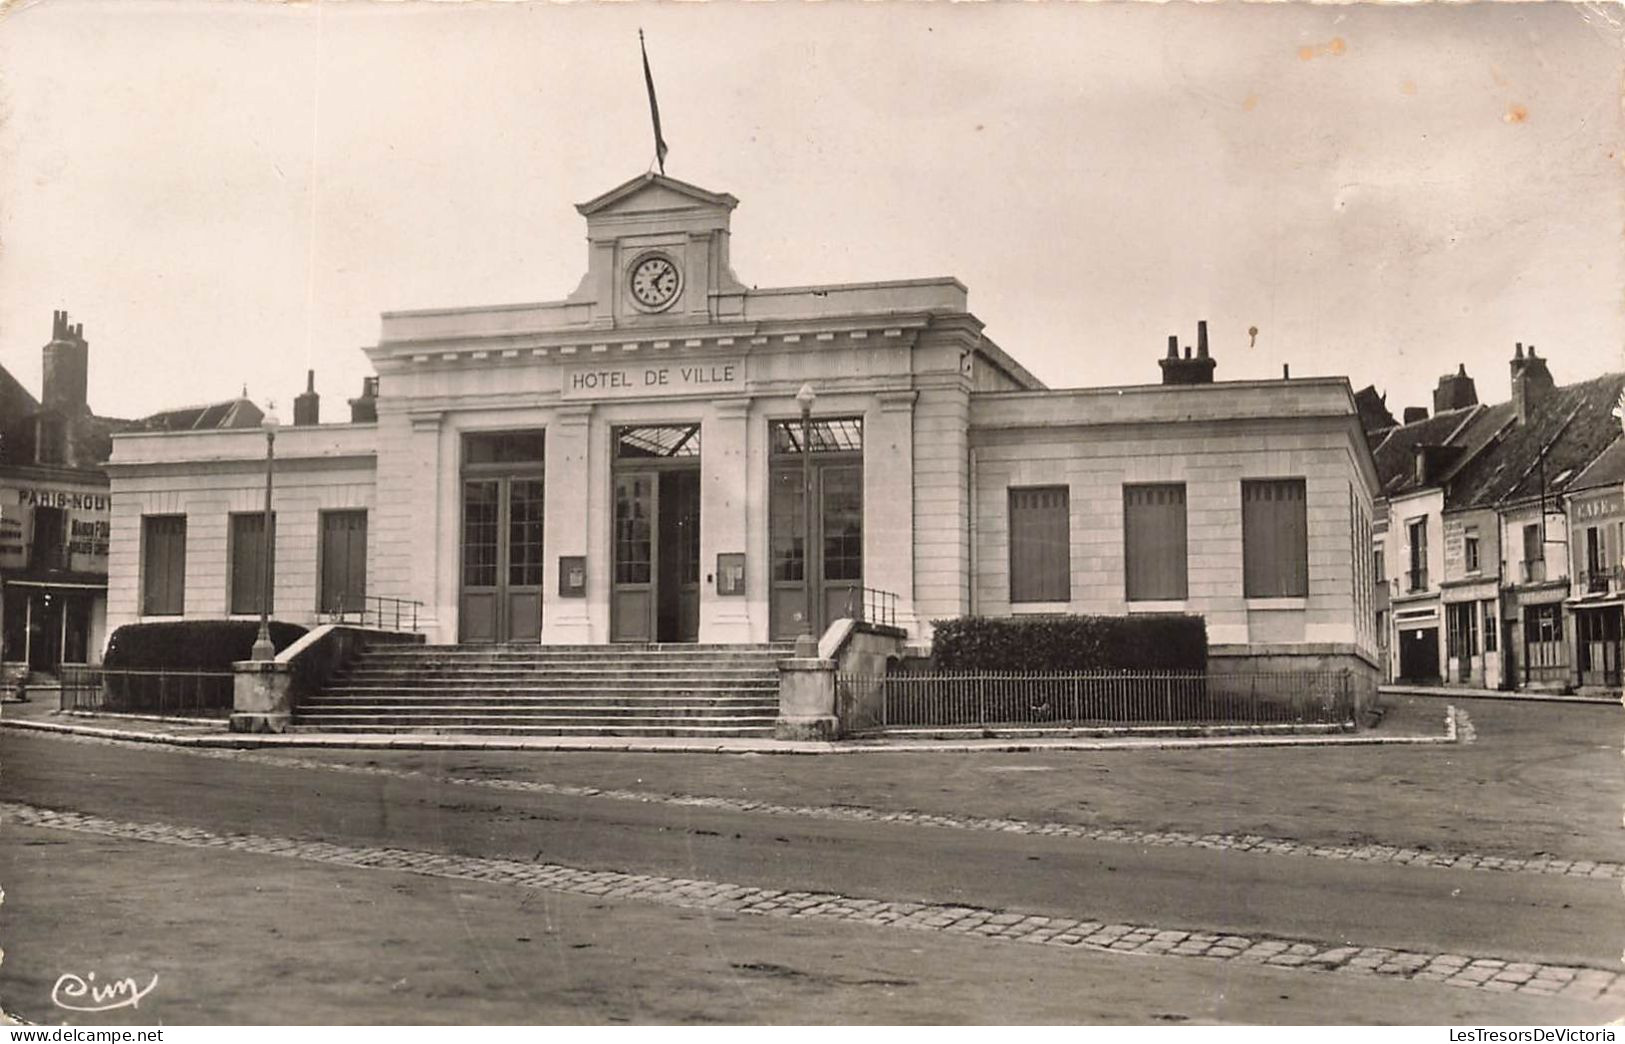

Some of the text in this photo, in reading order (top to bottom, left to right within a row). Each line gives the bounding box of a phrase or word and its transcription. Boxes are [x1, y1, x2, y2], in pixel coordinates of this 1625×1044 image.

[573, 366, 735, 389] HOTEL DE VILLE
